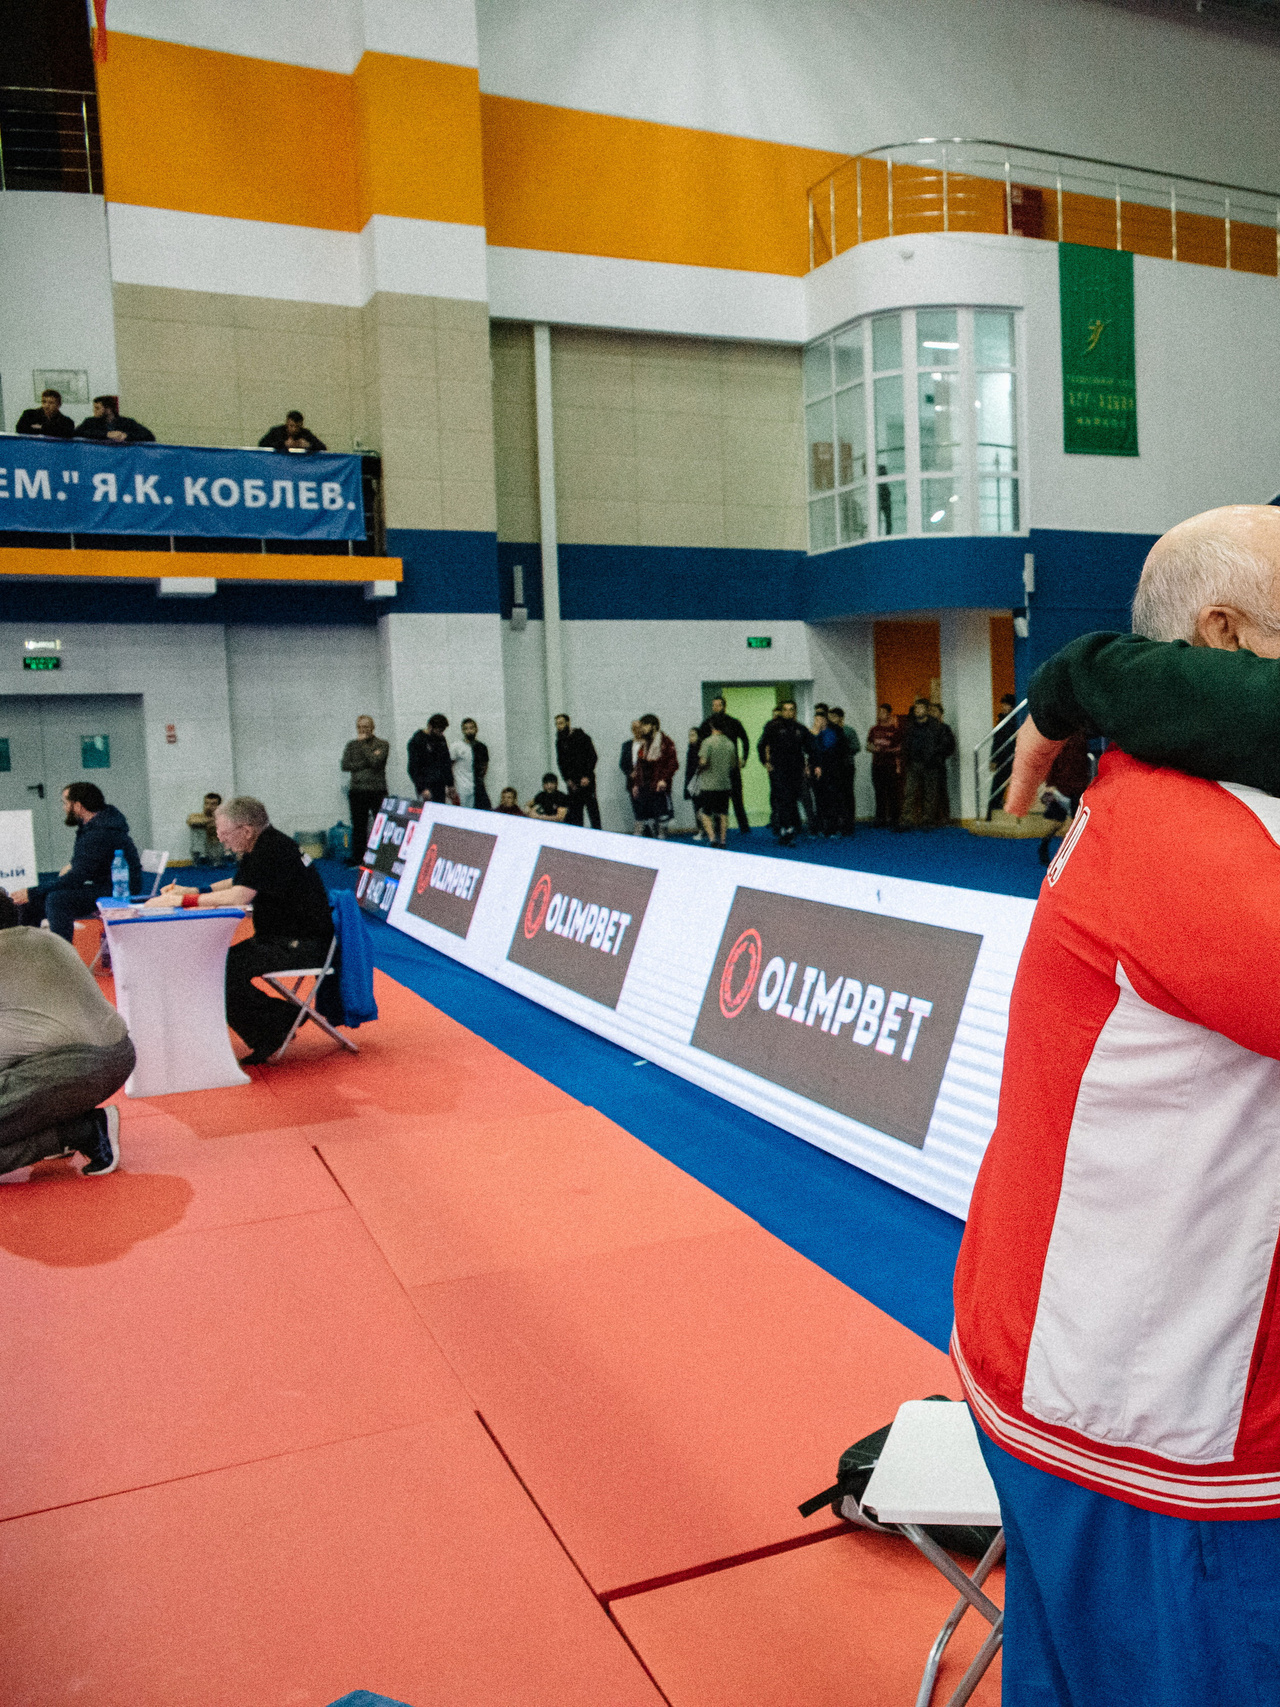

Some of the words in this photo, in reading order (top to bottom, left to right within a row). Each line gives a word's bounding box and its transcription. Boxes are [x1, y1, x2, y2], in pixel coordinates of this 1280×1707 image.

[92, 472, 174, 505] Я.К.
[184, 476, 356, 511] КОБЛЕВ.
[429, 856, 481, 901] OLIMPBET
[545, 893, 632, 956] OLIMPBET
[757, 956, 933, 1061] OLIMPBET
